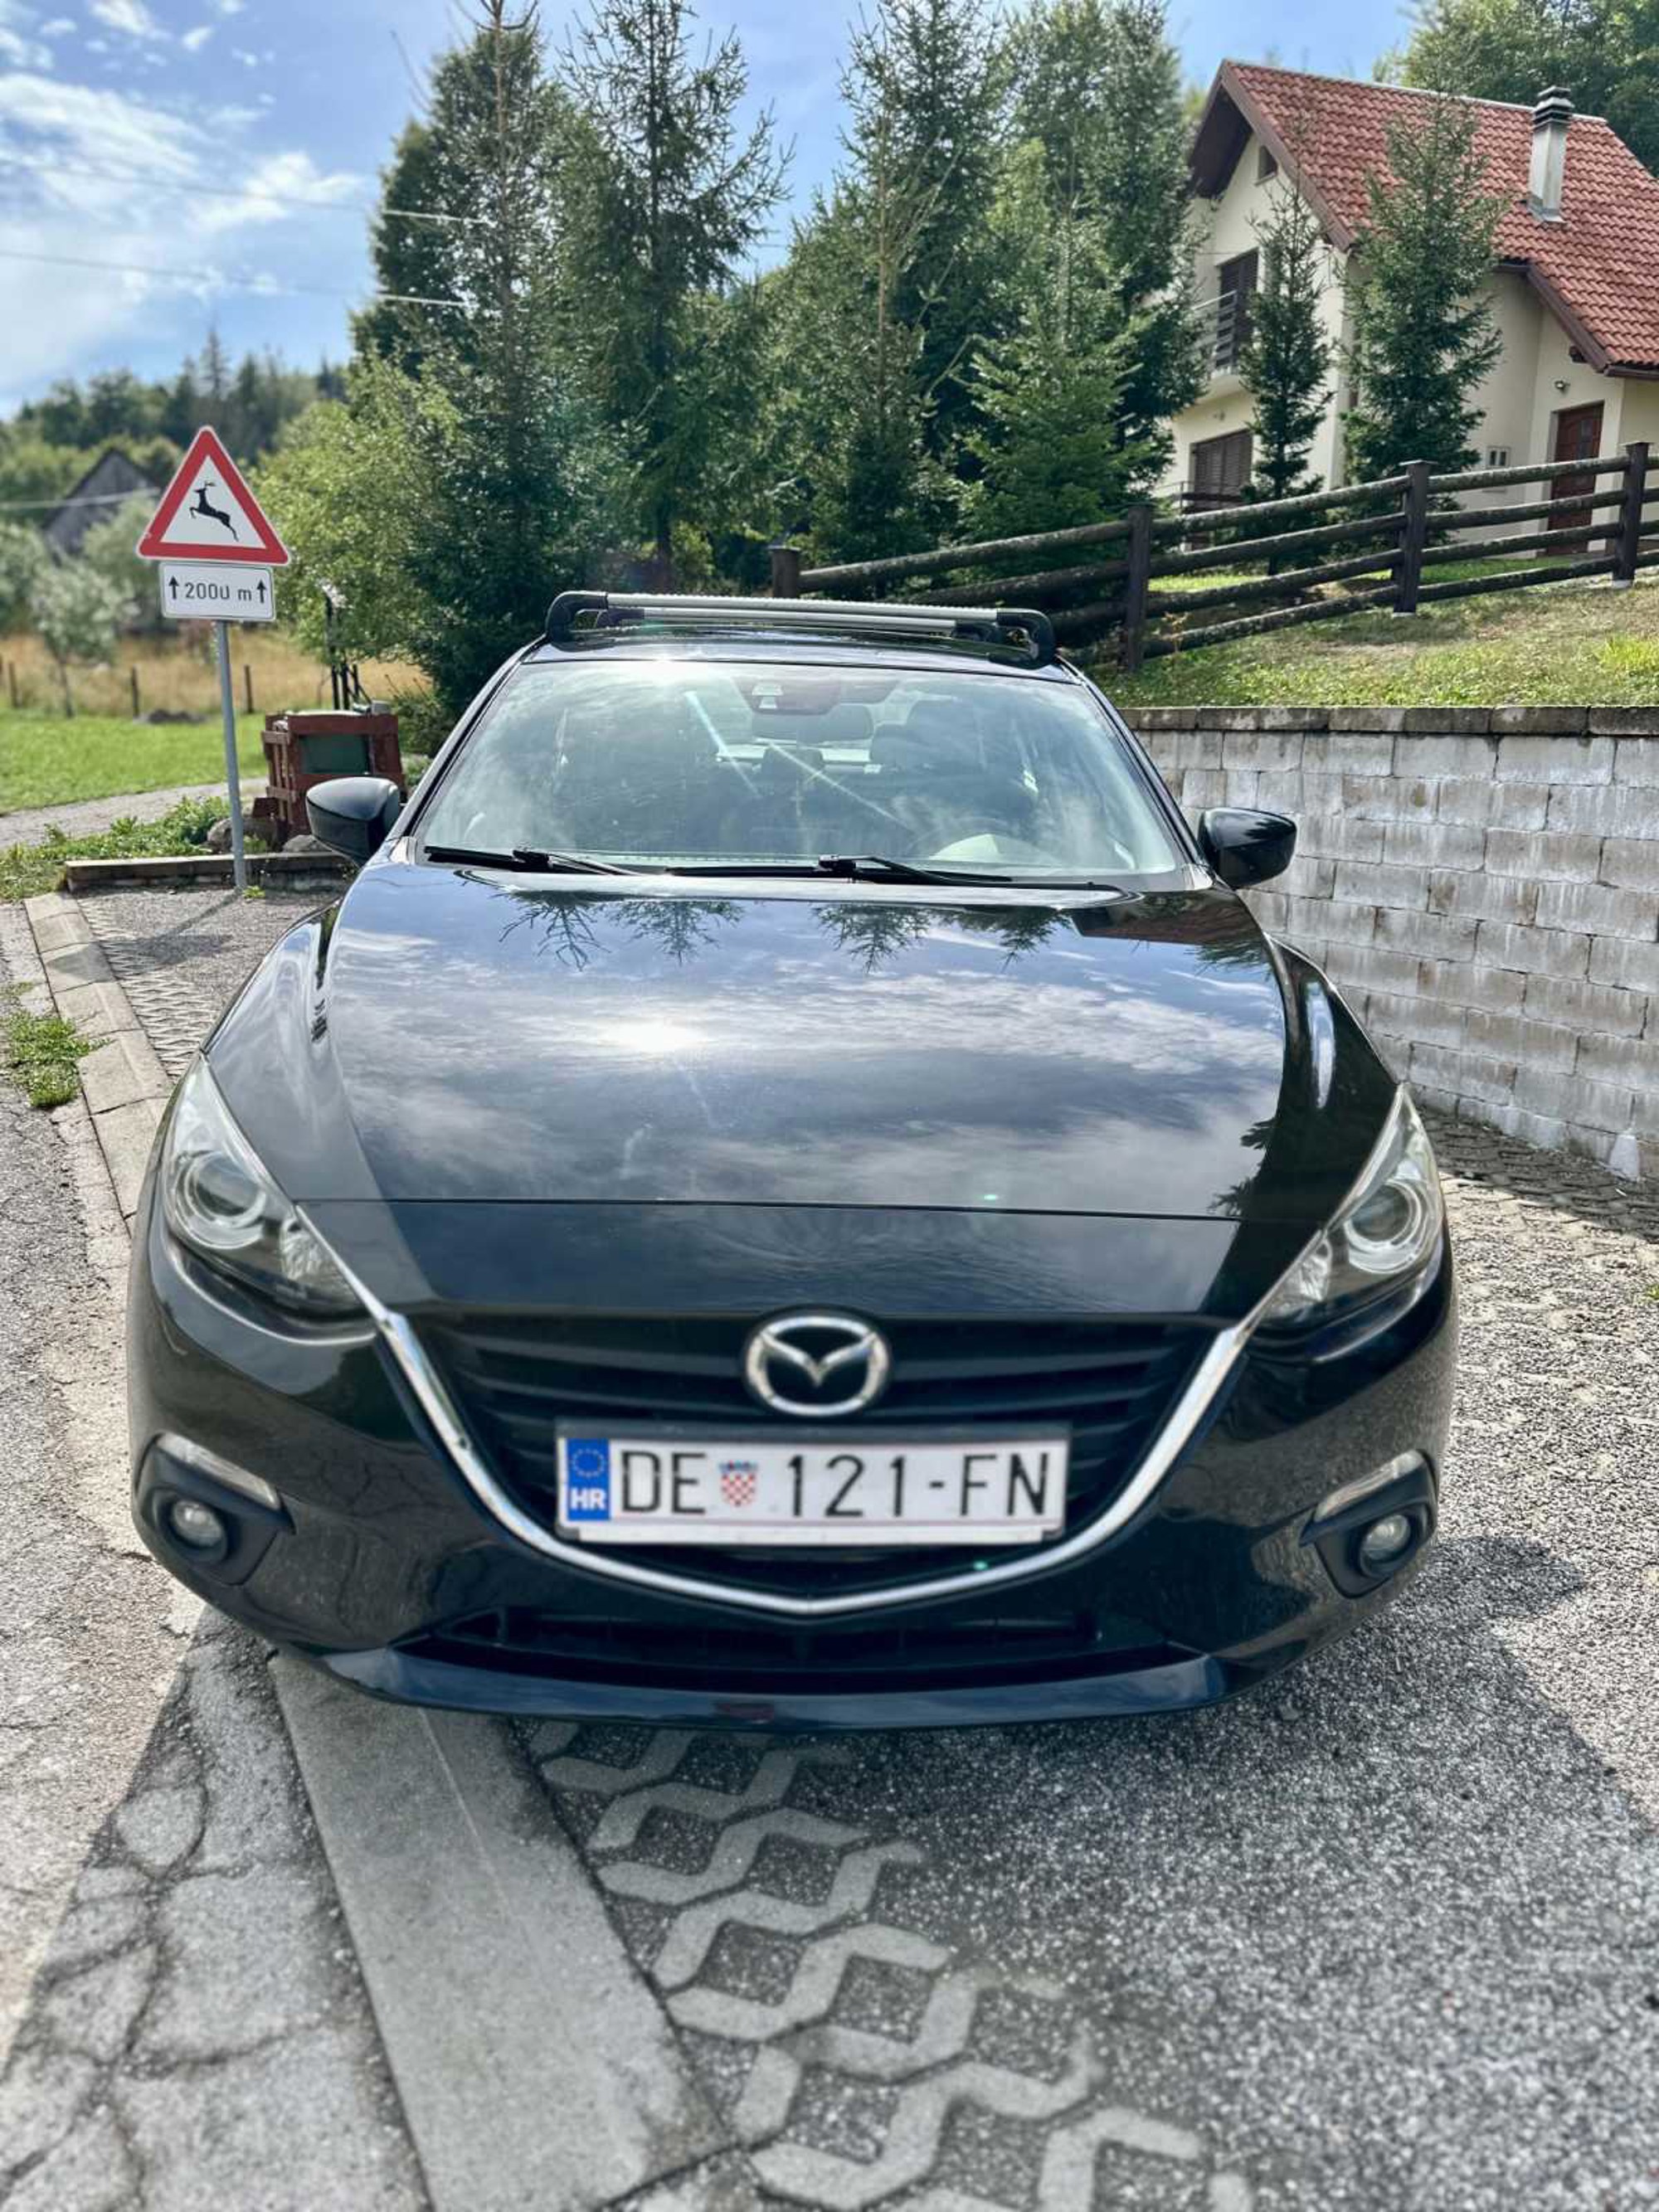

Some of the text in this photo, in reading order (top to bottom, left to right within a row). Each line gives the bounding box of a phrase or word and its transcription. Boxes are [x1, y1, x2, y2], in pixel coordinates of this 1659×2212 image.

[237, 589, 252, 601] m
[620, 1451, 1048, 1517] DE 121-FN
[570, 1490, 606, 1510] HR
